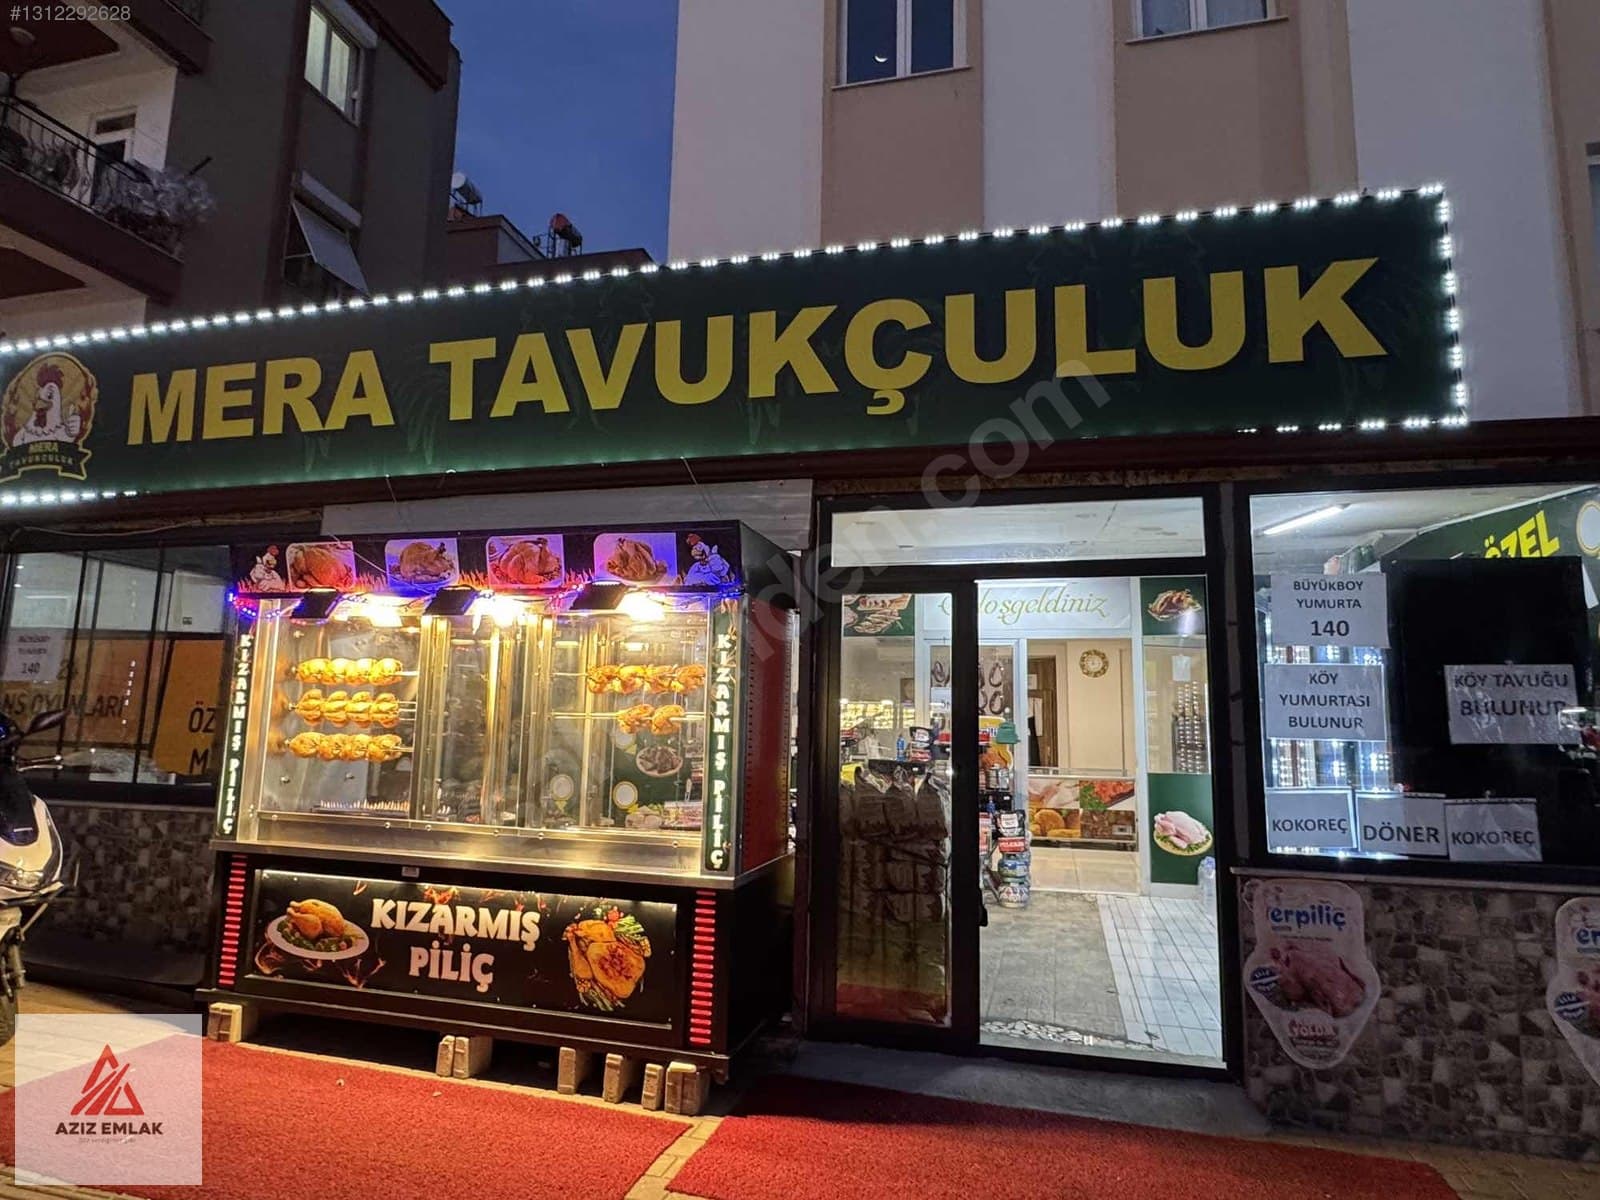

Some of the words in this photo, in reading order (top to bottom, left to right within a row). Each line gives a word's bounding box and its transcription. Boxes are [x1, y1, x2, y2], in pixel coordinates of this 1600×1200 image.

[127, 349, 395, 445] MERA
[428, 257, 1388, 420] TAVUKÇULUK
[1293, 579, 1363, 591] BÜYÜKBOY
[1296, 598, 1362, 609] YUMURTA
[1311, 620, 1350, 637] 140
[1309, 672, 1338, 685] KÖY
[1454, 672, 1487, 687] KÖY
[1491, 672, 1568, 687] TAVUĞU
[1280, 694, 1370, 708] YUMURTASI
[1460, 700, 1567, 716] BULUNUR
[1288, 716, 1363, 729] BULUNUR
[1272, 818, 1348, 833] KOKOREÇ
[1364, 821, 1440, 844] DÖNER
[1452, 831, 1535, 846] KOKOREÇ
[371, 898, 541, 951] KIZARMIŞ
[1270, 904, 1346, 932] erpiliç
[409, 940, 495, 992] PİLİÇ
